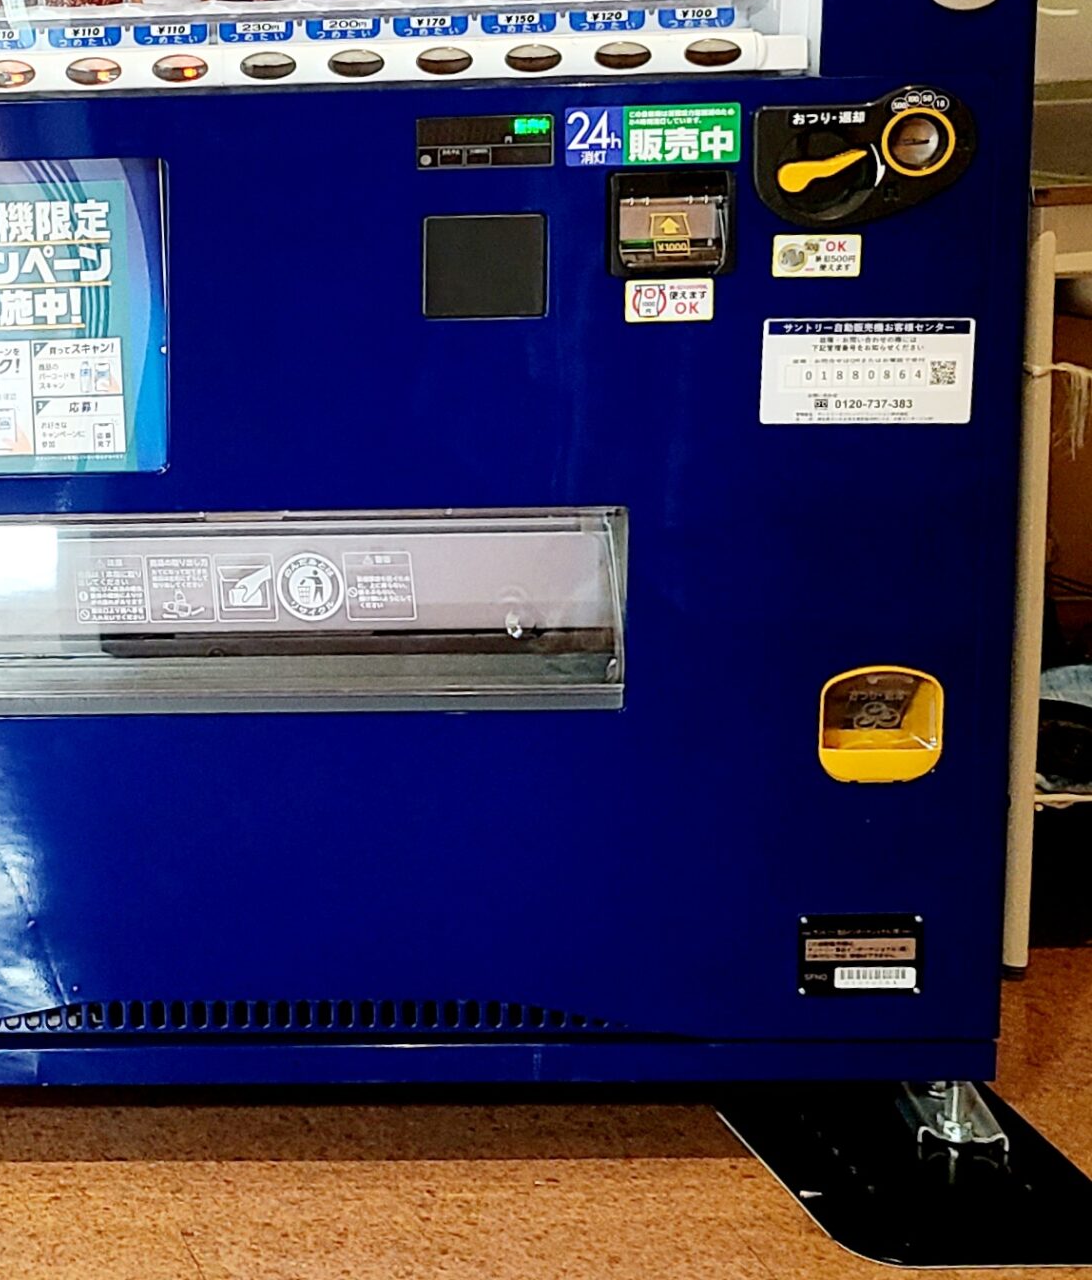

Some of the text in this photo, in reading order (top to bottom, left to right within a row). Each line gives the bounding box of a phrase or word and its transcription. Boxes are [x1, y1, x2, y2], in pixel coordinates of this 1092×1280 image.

[592, 11, 623, 21] ¥120
[682, 9, 712, 18] ¥100
[329, 19, 367, 29] 200円
[417, 17, 446, 26] ¥170
[506, 14, 535, 24] ¥150
[669, 18, 726, 28] つめたい
[73, 27, 100, 37] ¥110
[158, 25, 185, 35] ¥110
[242, 22, 280, 32] 230円
[491, 23, 547, 33] つめたい
[316, 30, 371, 39] つめたい
[145, 35, 198, 45] つめたい
[567, 110, 622, 150] 24h
[628, 124, 734, 162] 販売中
[580, 150, 607, 165] 消灯
[825, 240, 848, 252] OK
[674, 301, 700, 315] OK
[783, 322, 956, 334] サントリー自動販売機お客様センター
[834, 398, 914, 410] 0120-737-383
